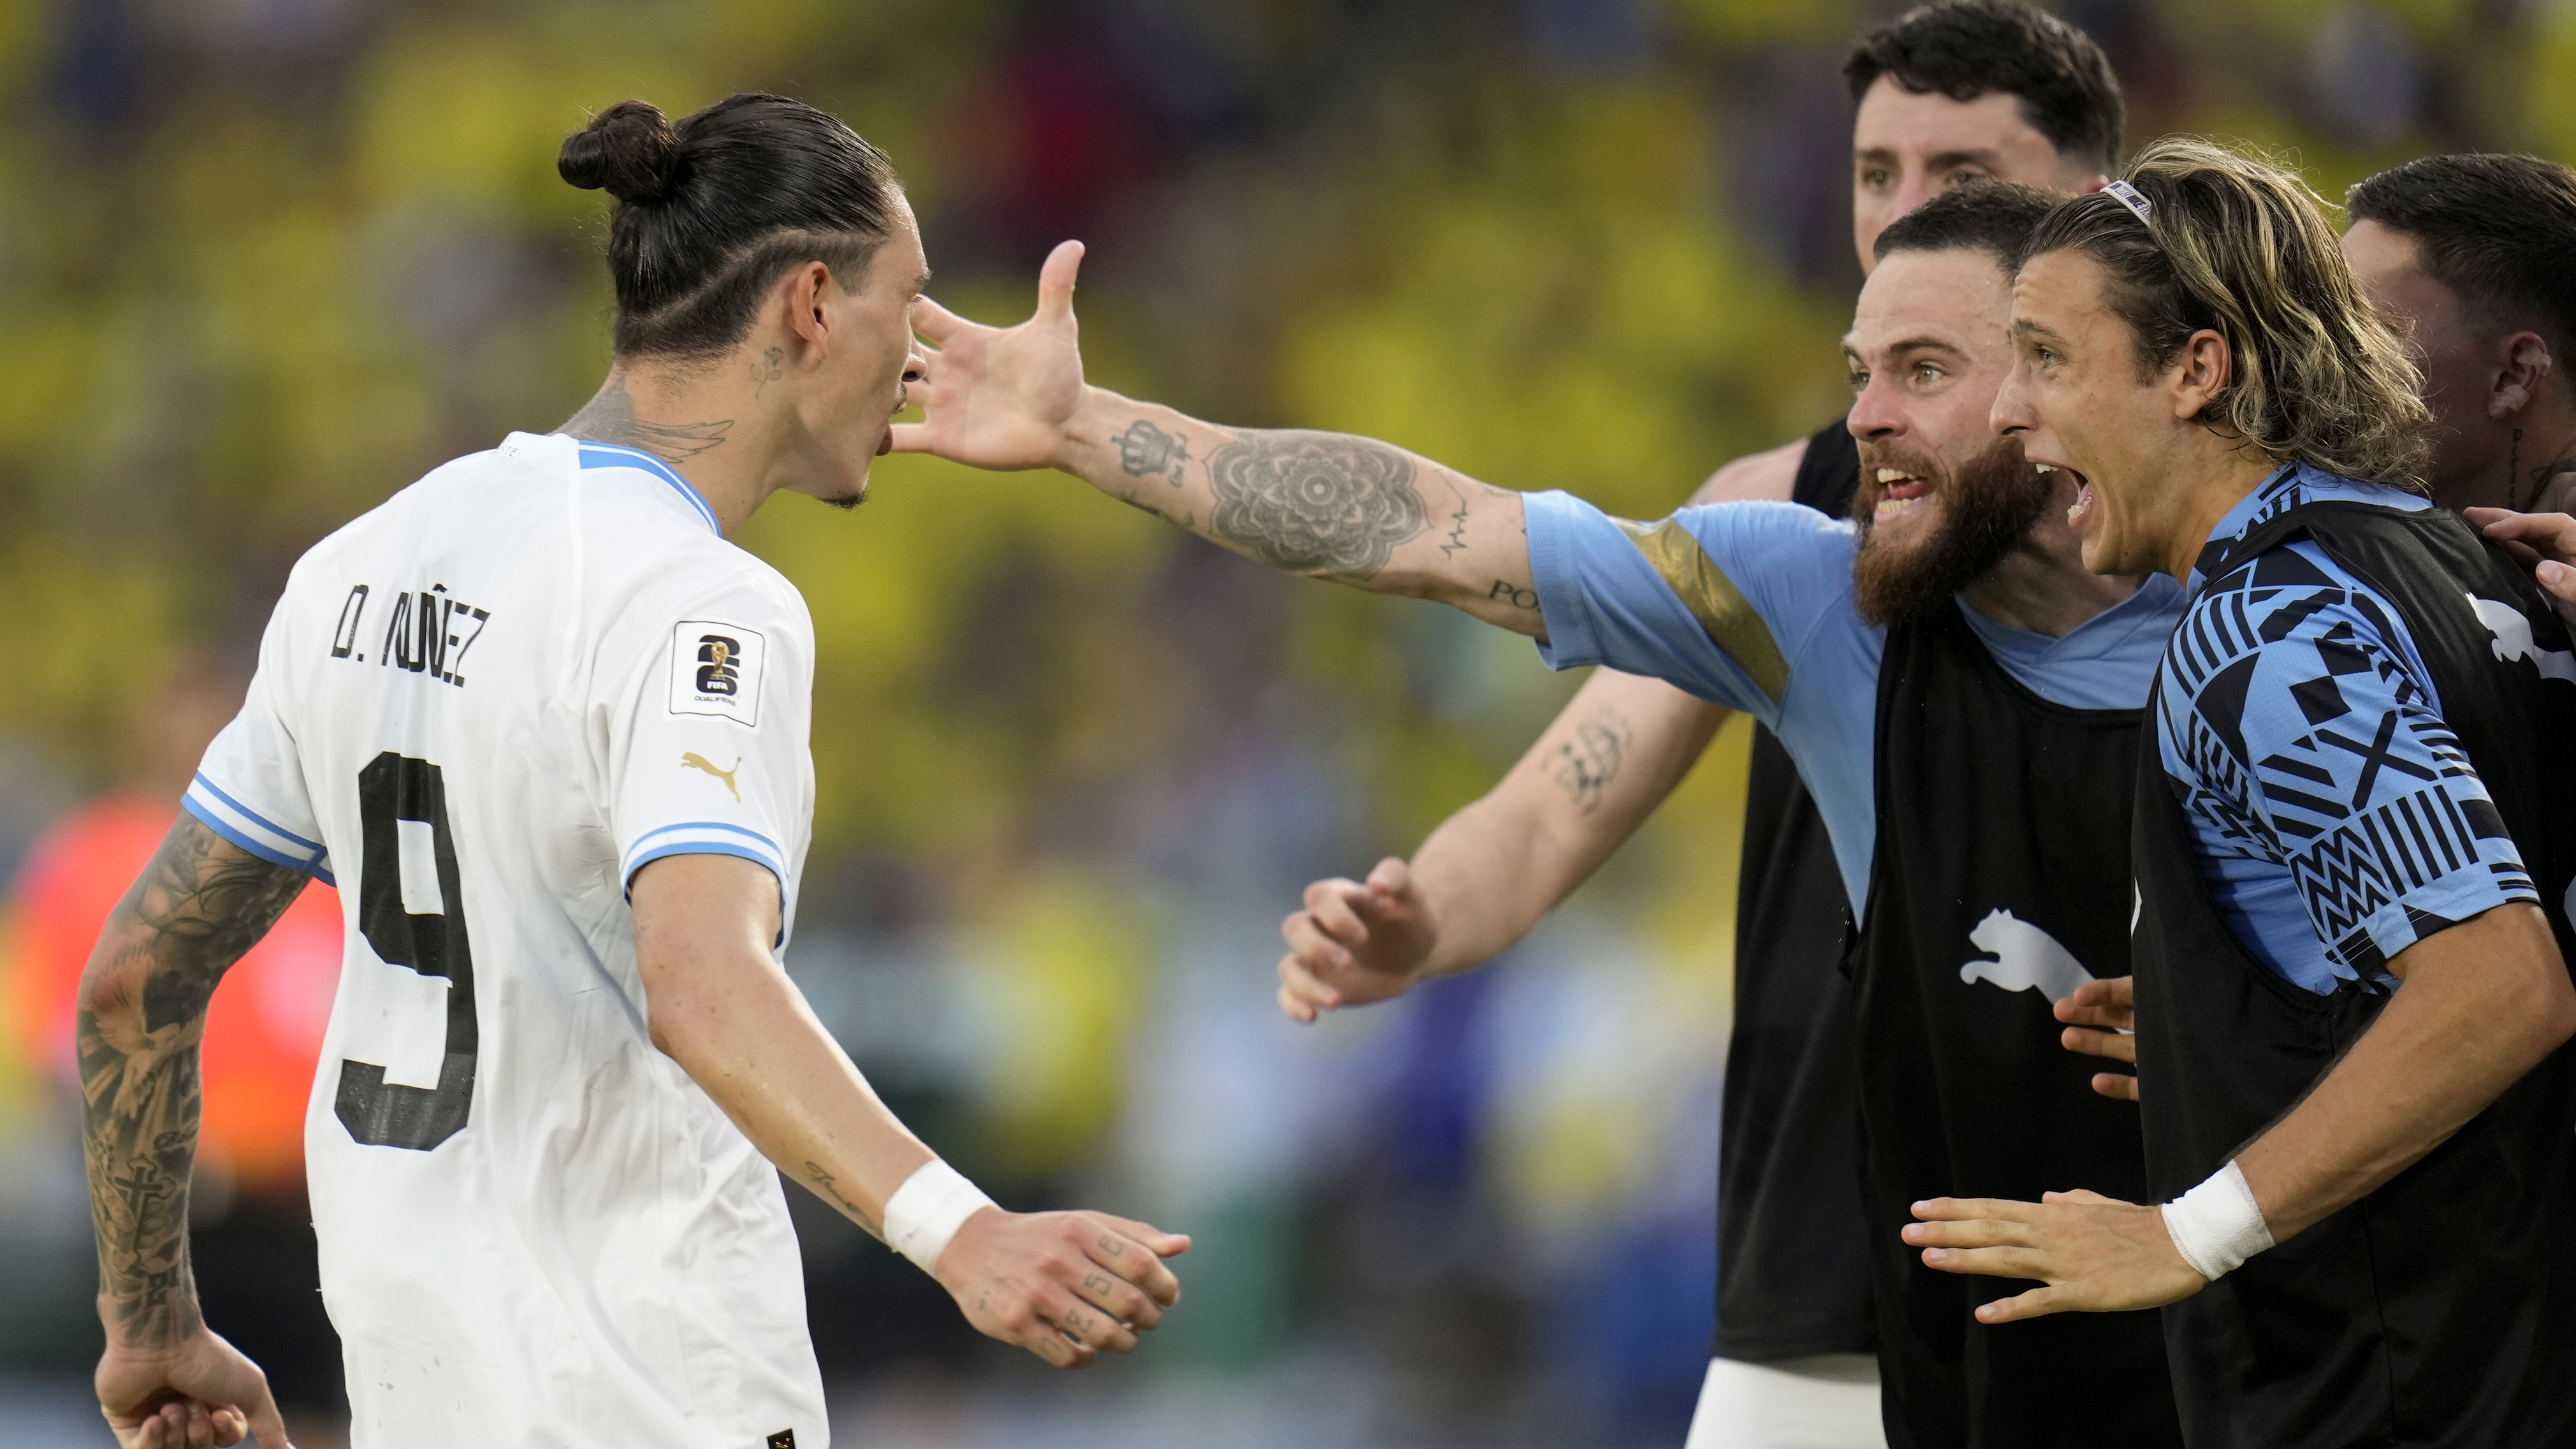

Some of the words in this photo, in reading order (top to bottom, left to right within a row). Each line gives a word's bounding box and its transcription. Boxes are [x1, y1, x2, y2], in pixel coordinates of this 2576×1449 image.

[2125, 194, 2146, 208] NIKE
[706, 681, 729, 690] FIFA
[694, 695, 736, 706] QUALIFIERS
[334, 750, 479, 1152] 9
